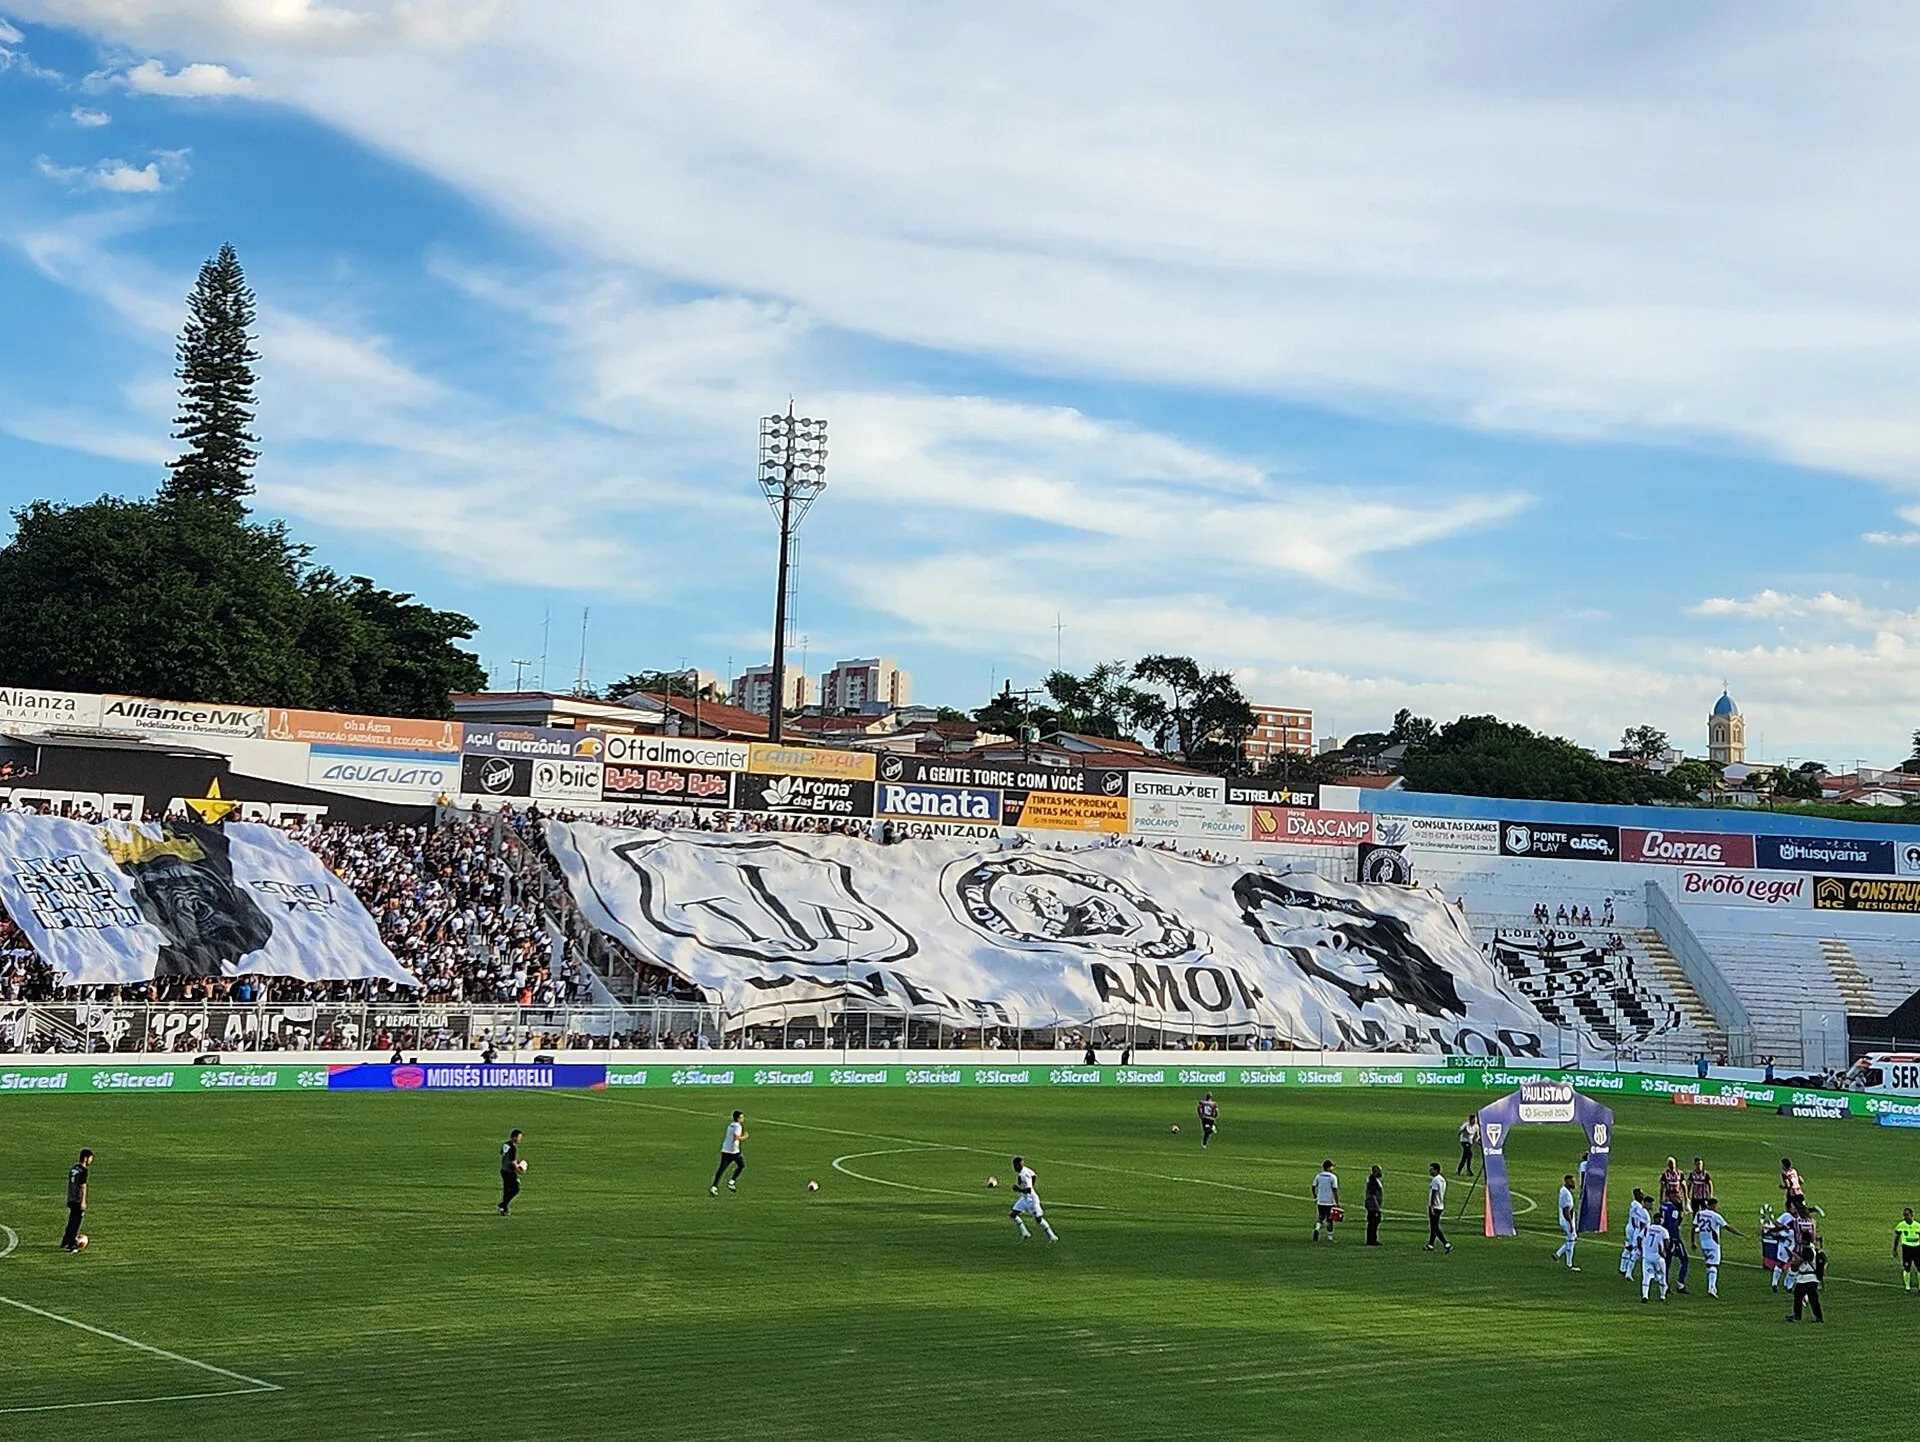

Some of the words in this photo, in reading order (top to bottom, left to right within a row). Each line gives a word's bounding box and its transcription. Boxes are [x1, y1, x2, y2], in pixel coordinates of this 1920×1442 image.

[0, 691, 76, 711] Alianza
[465, 732, 494, 747] AÇAÍ
[497, 738, 571, 756] amazônia
[607, 737, 748, 768] Oftalmocenter
[323, 765, 444, 786] AGUAJATO
[605, 768, 645, 791] Bob's
[646, 770, 685, 795] Bob's
[687, 773, 727, 797] Bob's
[917, 765, 927, 781] A
[929, 766, 971, 784] GENTE
[972, 768, 1015, 787] TORCE
[1019, 772, 1048, 789] COM
[1051, 773, 1086, 792] VOCÊ
[790, 777, 850, 797] Aroma
[1135, 782, 1184, 798] ESTRELA
[1197, 785, 1219, 799] BET
[793, 795, 812, 807] das
[812, 796, 854, 813] Ervas
[884, 785, 991, 819] Renata
[1031, 795, 1062, 807] TINTAS
[1229, 787, 1280, 803] ESTRELA
[1292, 792, 1315, 806] BET
[1028, 806, 1058, 817] TINTAS
[884, 821, 1001, 840] RGANIZADA
[1134, 817, 1179, 829] PROCAMPO
[1201, 821, 1246, 833] PROCAMPO
[1287, 817, 1370, 839] BRASCAMP
[1412, 820, 1463, 831] CONSULTAS
[1464, 822, 1497, 832] EXAMES
[1533, 831, 1568, 843] PONTE
[1533, 842, 1560, 853] PLAY
[1794, 845, 1868, 863] Husqvarna
[1684, 872, 1745, 895] Broto
[1746, 877, 1805, 904] Legal
[1818, 899, 1845, 909] HC
[1857, 901, 1920, 912] RESIDENCI
[0, 1072, 69, 1090] Sicredi
[109, 1071, 175, 1088] Sicredi
[217, 1071, 279, 1087] Sicredi
[427, 1065, 481, 1087] MOISÉS
[483, 1069, 554, 1088] LUCARELLI
[606, 1070, 649, 1086] icredi
[684, 1070, 735, 1086] Sicredi
[767, 1070, 815, 1085] Sicredi
[842, 1070, 889, 1085] Sicredi
[917, 1070, 962, 1085] Sicredi
[985, 1070, 1030, 1085] Sicredi
[1061, 1070, 1101, 1085] Sicredi
[1126, 1070, 1164, 1085] Sicredi
[1191, 1070, 1226, 1085] Sicredi
[1250, 1071, 1286, 1084] Sicredi
[1306, 1071, 1343, 1084] Sicredi
[1368, 1071, 1404, 1084] Sicredi
[1426, 1072, 1466, 1085] Sicredi
[1575, 1074, 1624, 1089] Sicredi
[1892, 1065, 1919, 1089] SER
[1653, 1080, 1701, 1095] Sicredi
[1732, 1086, 1775, 1102] Sicredi
[1693, 1094, 1740, 1107] BETANO
[1804, 1092, 1849, 1109] Sicredi
[1792, 1105, 1843, 1119] novibet
